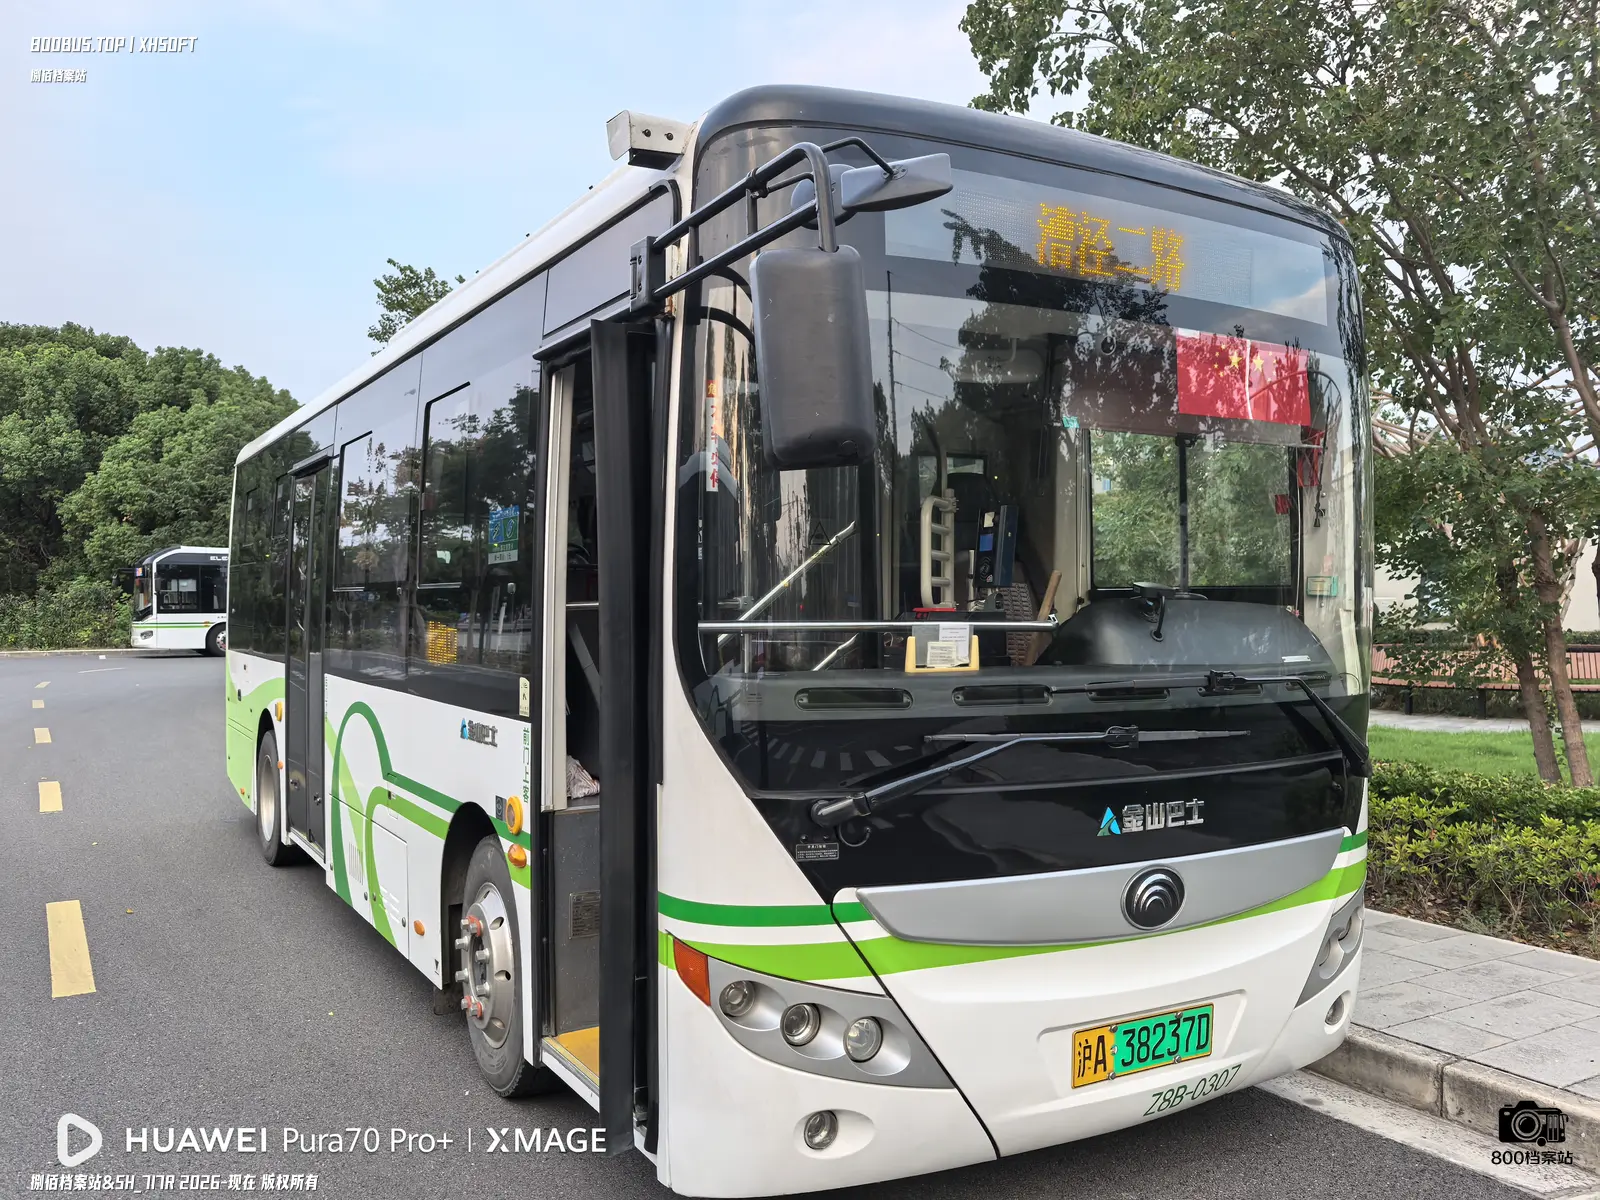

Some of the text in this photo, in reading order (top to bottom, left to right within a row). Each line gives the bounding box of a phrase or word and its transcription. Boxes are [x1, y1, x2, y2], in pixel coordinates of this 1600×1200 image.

[1036, 202, 1185, 291] 漕泾二路
[1122, 798, 1205, 834] 金山巴士
[1143, 1064, 1242, 1117] Z8B-0307
